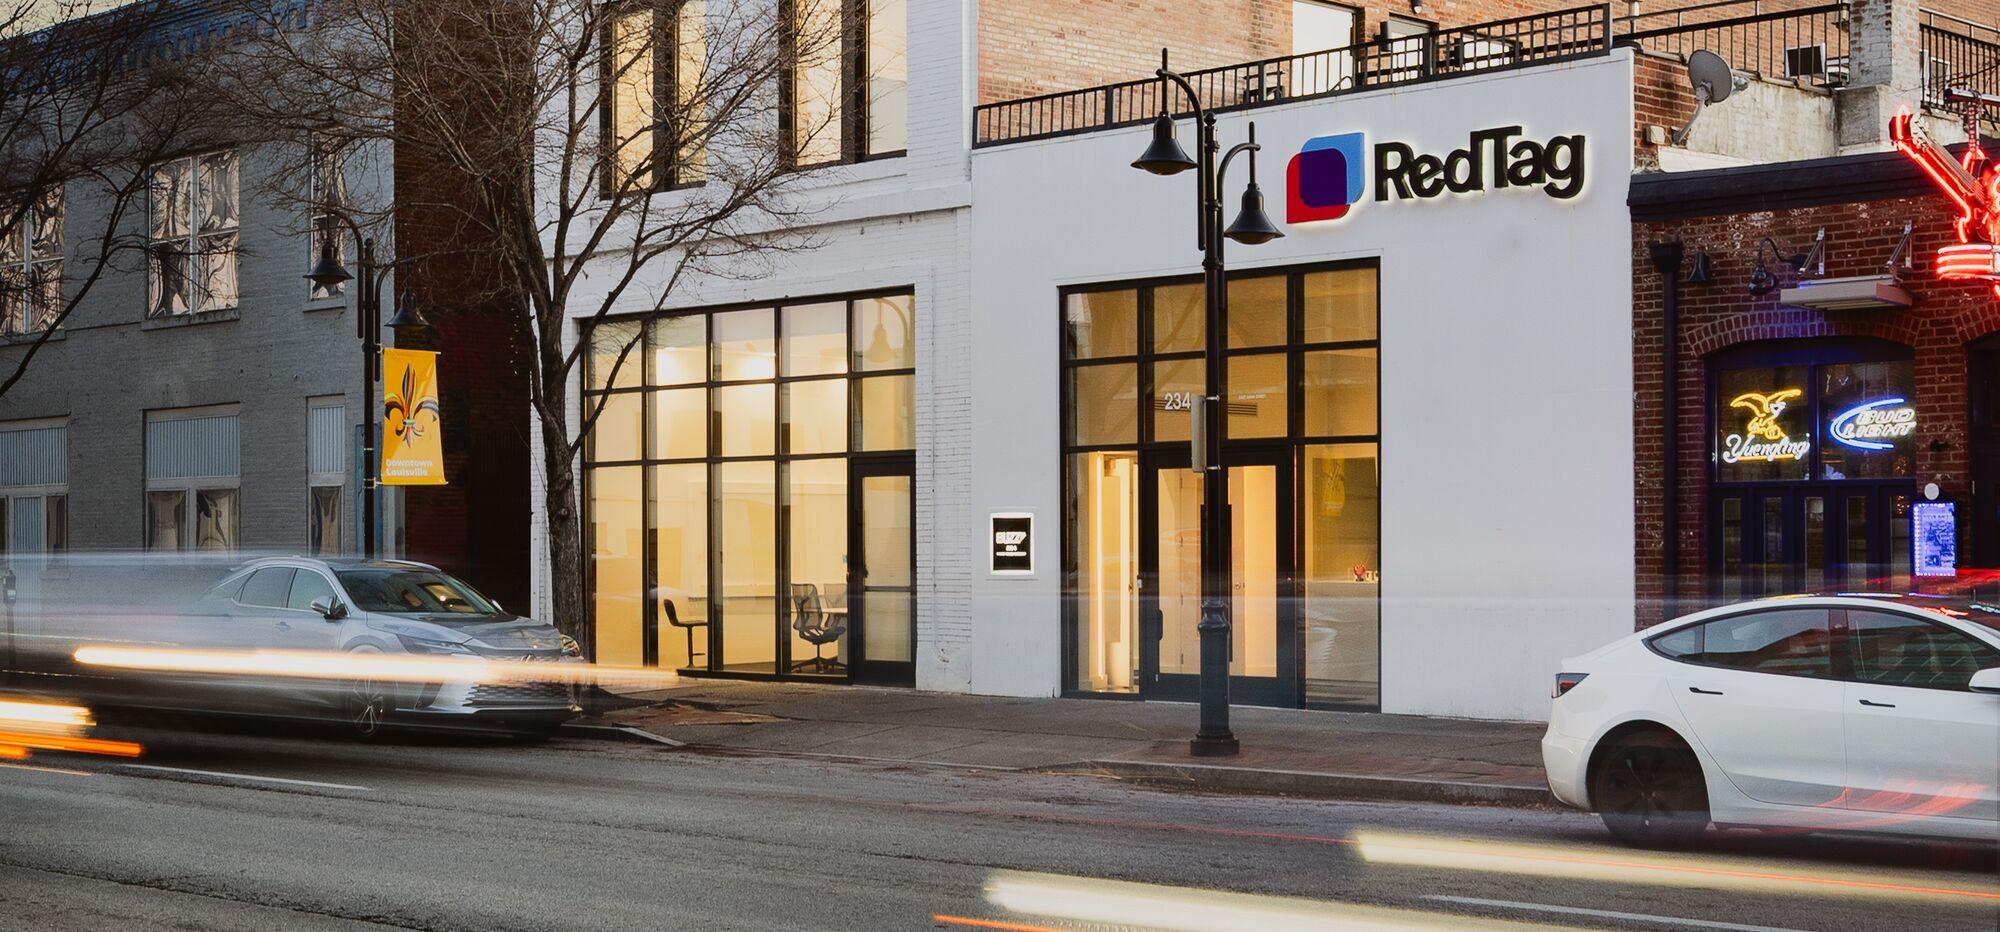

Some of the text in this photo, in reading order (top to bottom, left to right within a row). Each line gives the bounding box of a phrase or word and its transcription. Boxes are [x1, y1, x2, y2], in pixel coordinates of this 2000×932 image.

[1374, 125, 1586, 201] RedTag
[1164, 391, 1191, 411] 234
[1856, 408, 1915, 425] BUD
[1843, 421, 1917, 439] LIGHT
[1722, 433, 1810, 464] Yuengling
